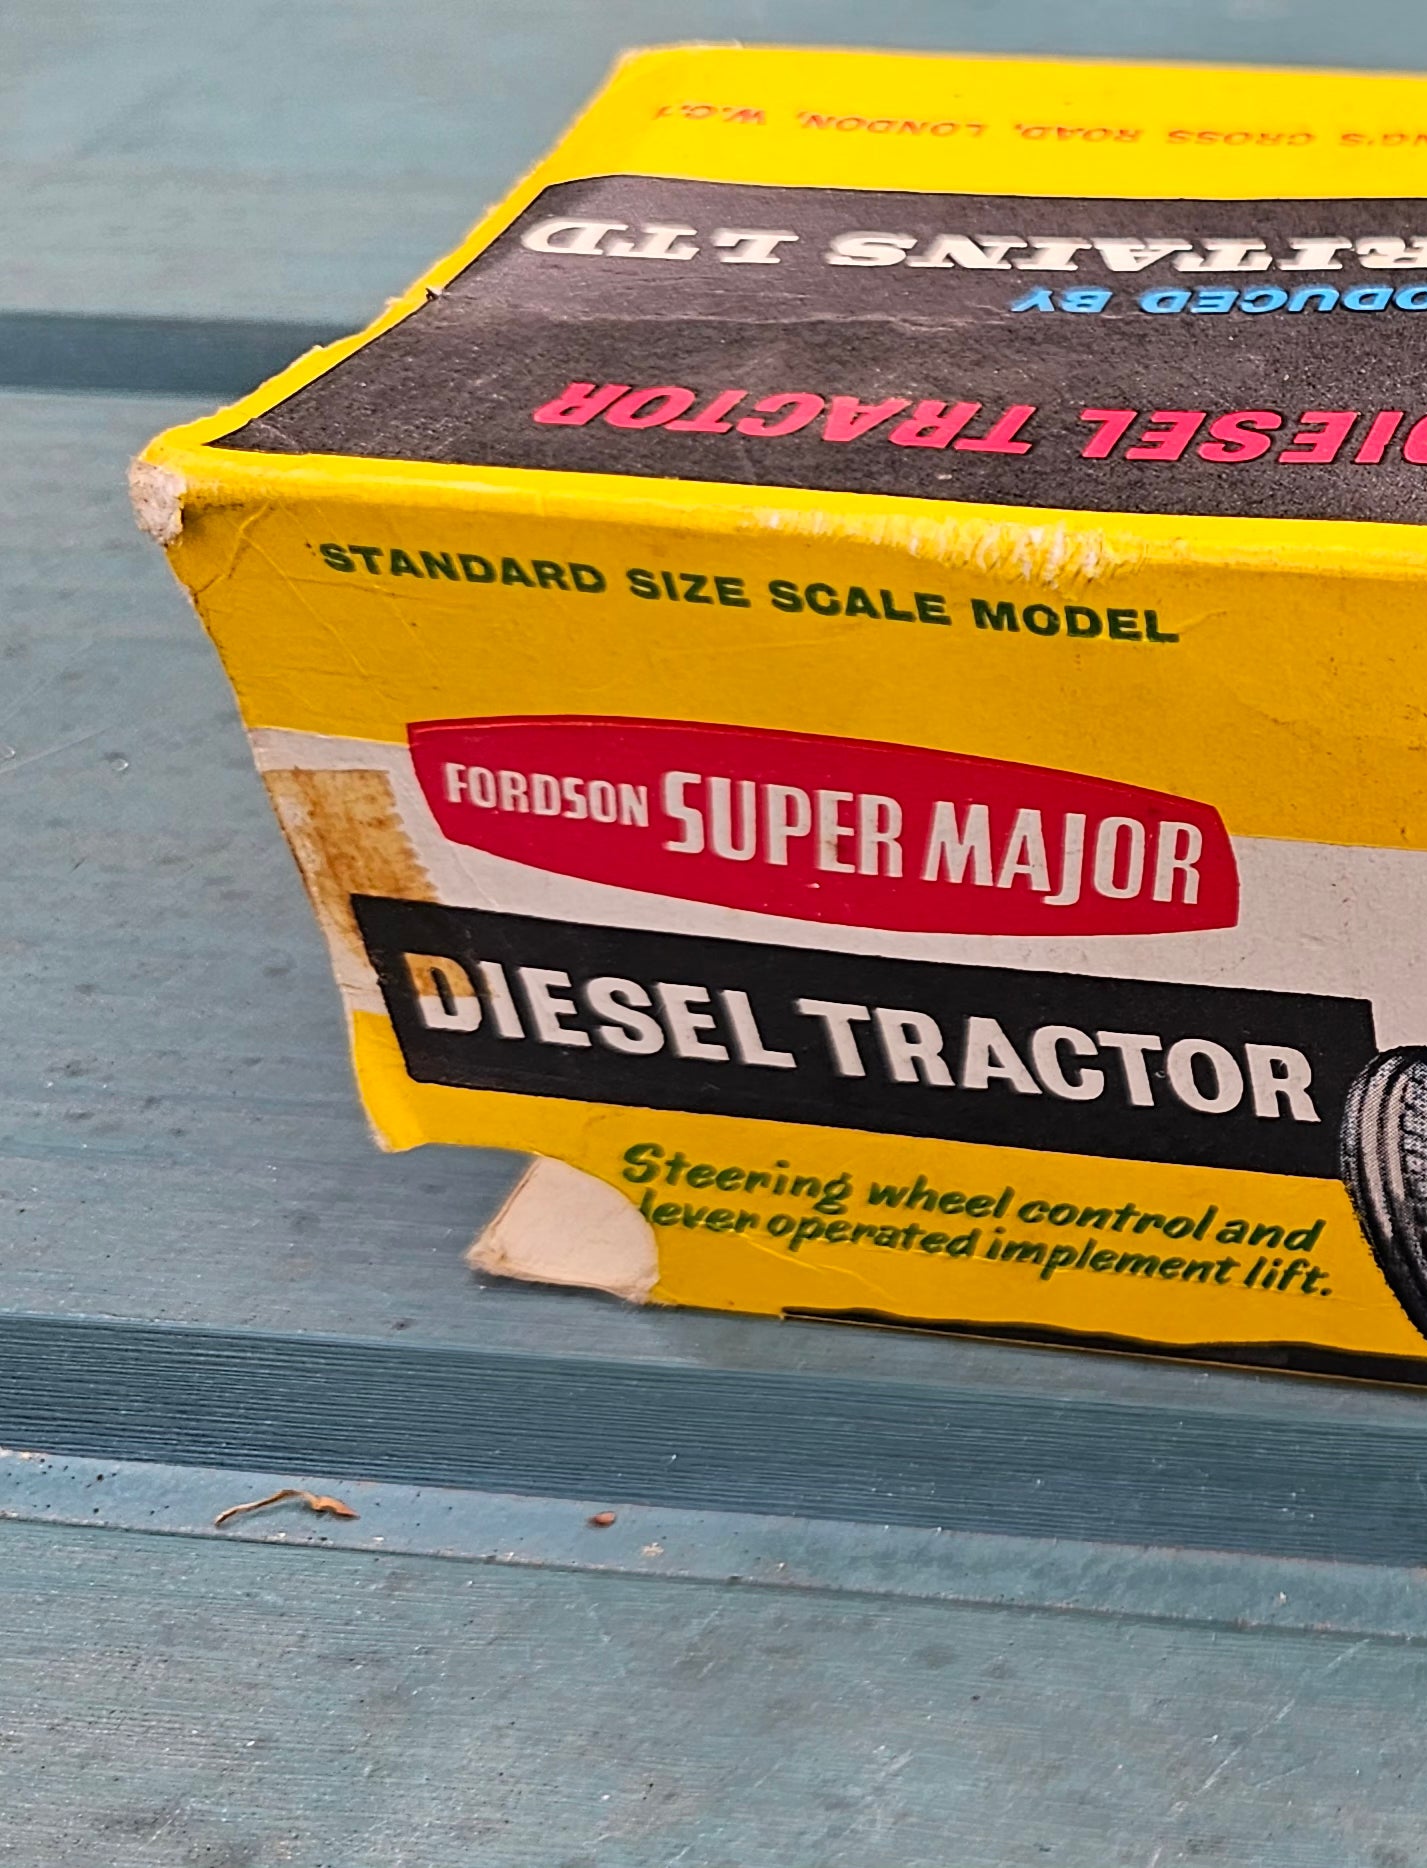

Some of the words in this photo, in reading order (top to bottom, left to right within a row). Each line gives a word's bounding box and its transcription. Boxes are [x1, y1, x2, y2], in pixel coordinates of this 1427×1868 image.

[1166, 128, 1316, 148] CROSS
[521, 216, 800, 265] LTD
[1009, 284, 1115, 314] BY
[532, 381, 1038, 455] TRACTOR
[319, 542, 607, 594] STANDARD
[626, 567, 752, 608] SIZE
[770, 578, 952, 626] SCALE
[972, 596, 1180, 644] MODEL
[444, 761, 650, 828] FORDSON
[662, 769, 904, 878] SUPER
[920, 800, 1202, 907] MAJOR
[402, 950, 798, 1071] DIESEL
[797, 998, 1322, 1124] TRACTOR
[621, 1141, 854, 1216] Steering
[867, 1172, 1015, 1223] wheel
[1016, 1194, 1217, 1242] control
[1217, 1217, 1327, 1254] and
[638, 1188, 758, 1234] lever
[766, 1207, 981, 1260] operated
[988, 1226, 1240, 1286] implement
[1243, 1247, 1333, 1298] lift.
